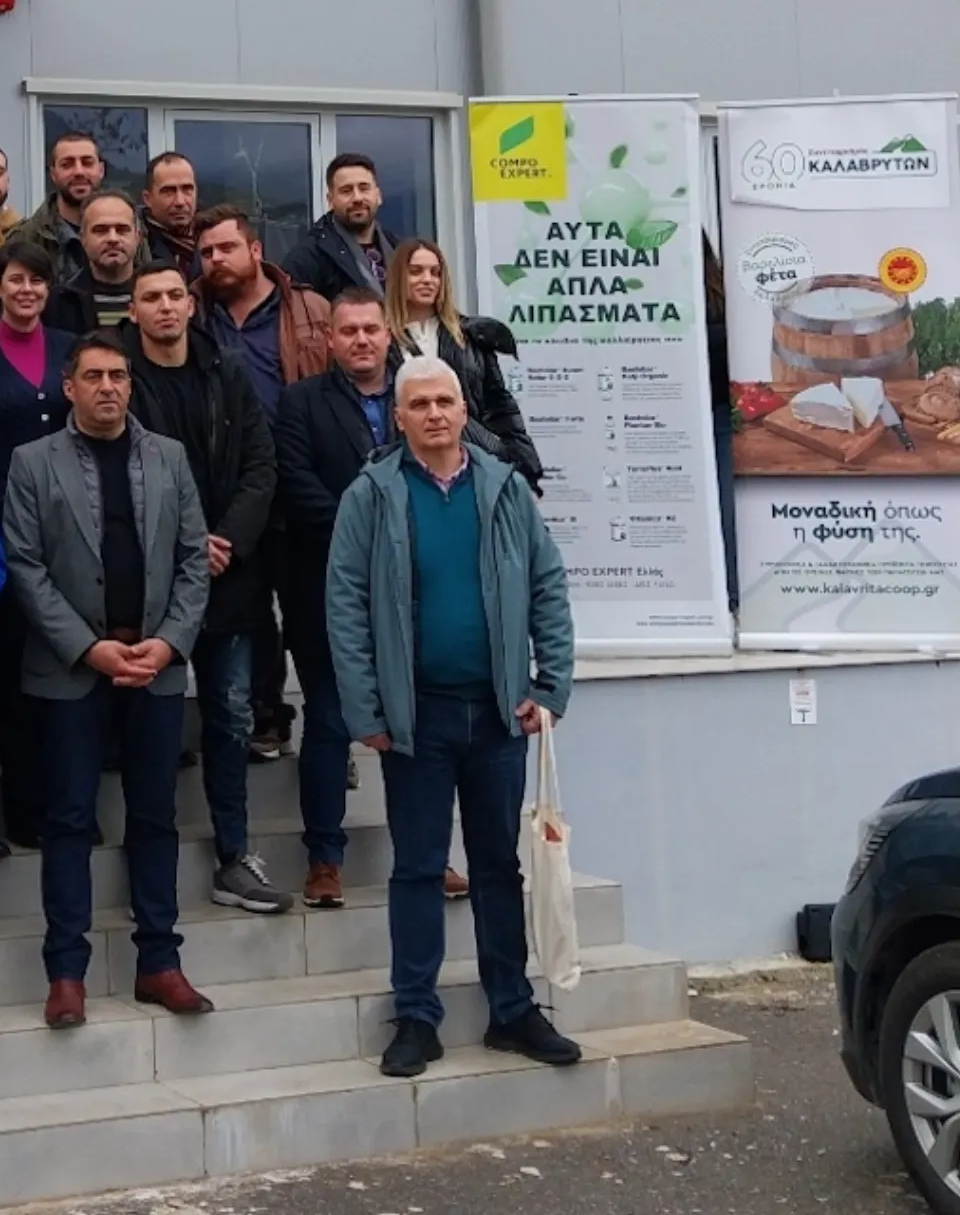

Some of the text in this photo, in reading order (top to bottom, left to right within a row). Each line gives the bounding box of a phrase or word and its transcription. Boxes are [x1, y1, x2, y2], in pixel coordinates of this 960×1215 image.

[490, 157, 538, 169] COMPO
[741, 138, 806, 184] 60
[808, 156, 930, 174] ΚΑΛΑΒΡΥΤΩΝ
[546, 221, 624, 241] ΑΥΤΑ
[514, 247, 660, 268] ΔΕΝ ΕΙΝΑΙ
[547, 276, 629, 296] ΑΠΛΑ
[508, 302, 682, 324] ΛΙΠΑΣΜΑΤΑ
[771, 499, 943, 522] Μοναδική όπως
[793, 521, 921, 543] η φύση της.
[592, 566, 633, 577] EXPERT
[779, 581, 940, 597] www.kalavritacoop.gr
